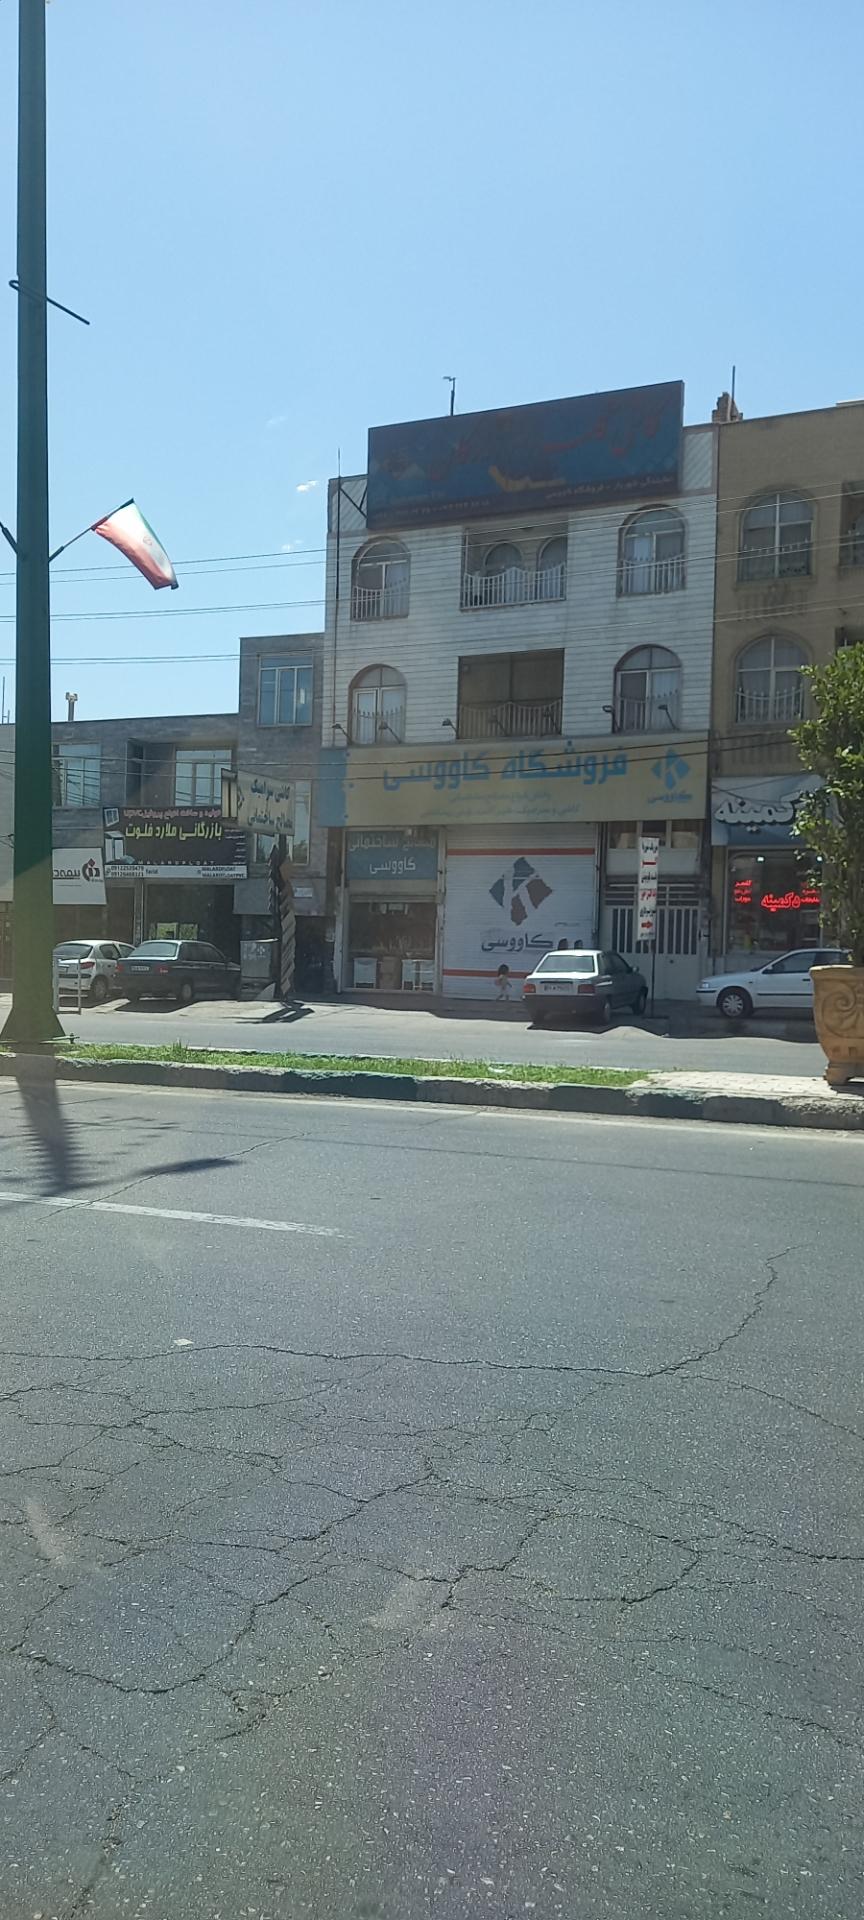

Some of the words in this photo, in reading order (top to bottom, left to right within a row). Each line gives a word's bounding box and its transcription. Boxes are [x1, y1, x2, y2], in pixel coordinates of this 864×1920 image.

[383, 751, 489, 791] کاووسی
[501, 739, 628, 785] فروشگاه
[647, 791, 693, 804] کاووسی
[125, 822, 153, 840] فلوت
[155, 821, 177, 840] ملارد
[178, 820, 223, 841] بازرگانی
[349, 834, 399, 852] ساختمانی
[369, 856, 417, 875] کاووسی
[481, 931, 555, 953] کاووسی
